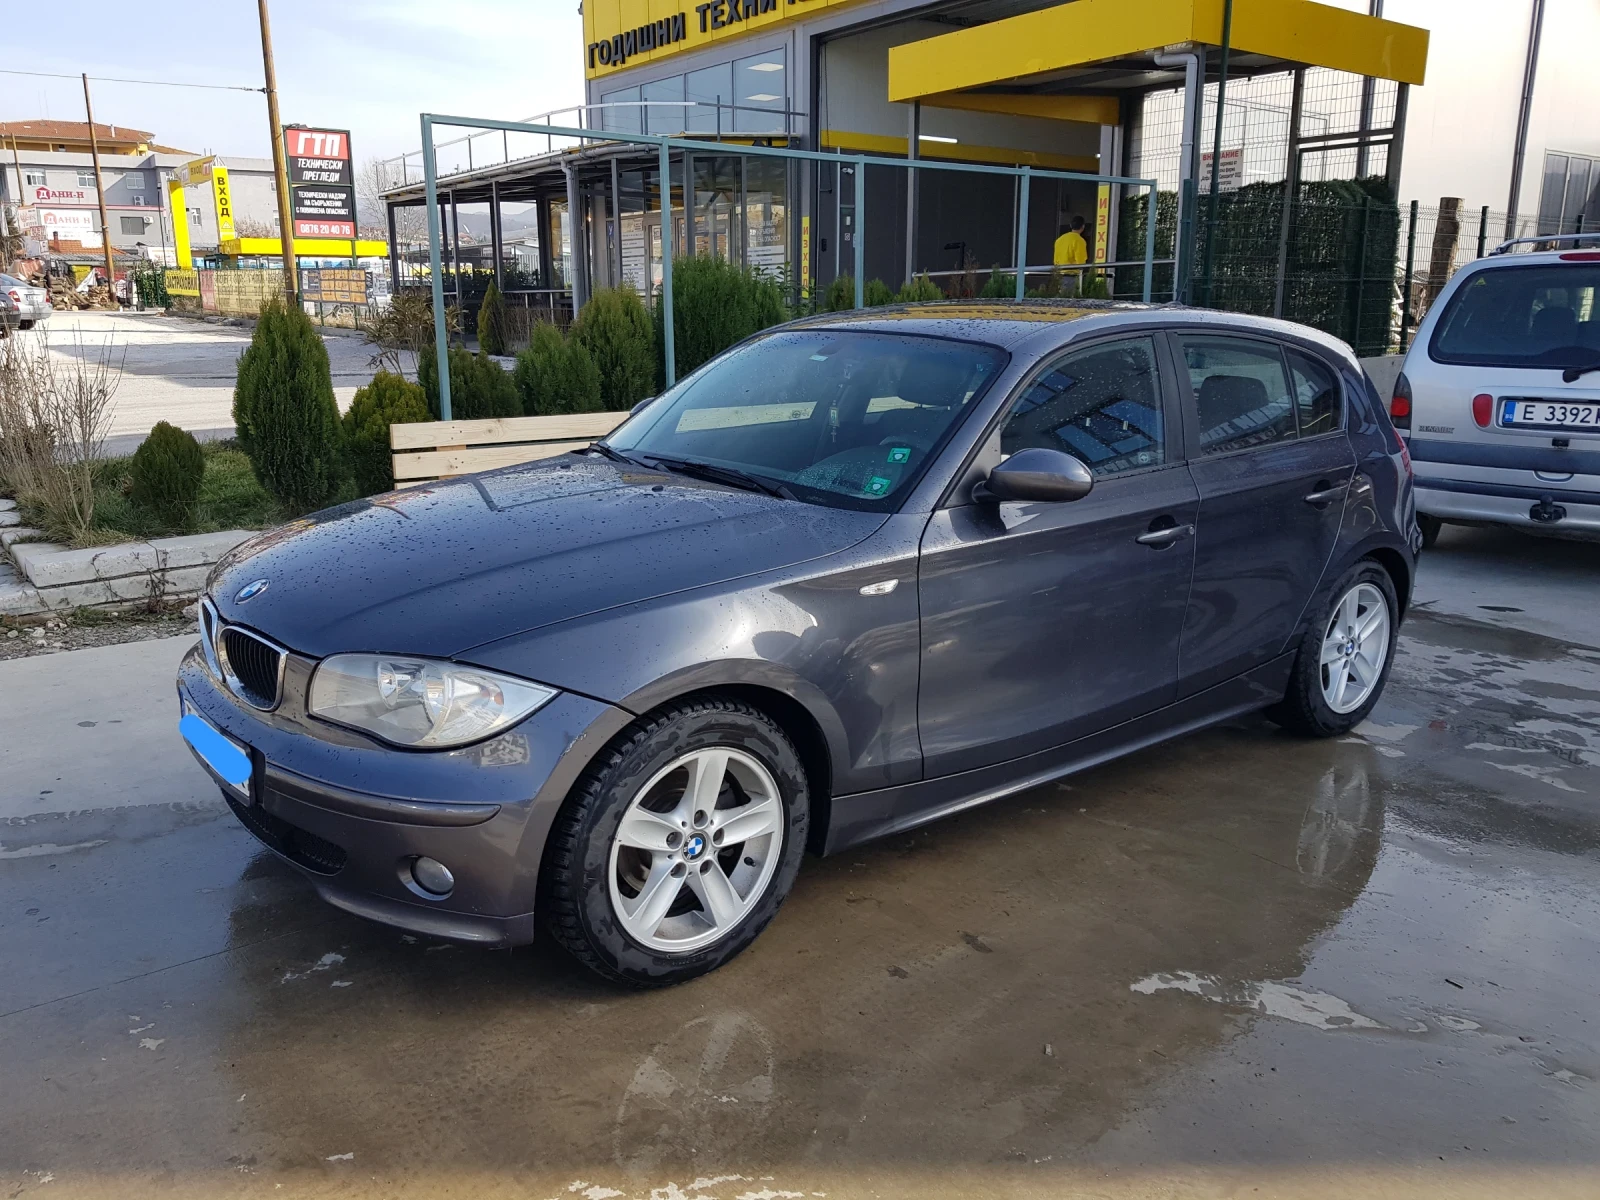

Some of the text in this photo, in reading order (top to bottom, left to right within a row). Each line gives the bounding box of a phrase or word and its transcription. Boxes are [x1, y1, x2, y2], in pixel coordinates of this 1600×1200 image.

[588, 12, 687, 69] ГОДИШНИ
[297, 132, 341, 157] ГТП
[298, 158, 343, 170] ТЕХНИЧЕСКИ
[302, 171, 340, 183] ПРЕГЛЕДИ
[37, 188, 84, 199] ДАНИ-Н
[217, 177, 230, 217] ВХОД
[298, 191, 327, 199] ТЕХНИЧЕСКИ
[300, 224, 350, 235] 0876 20 40 76
[1523, 404, 1536, 421] E
[1544, 405, 1593, 424] 3392
